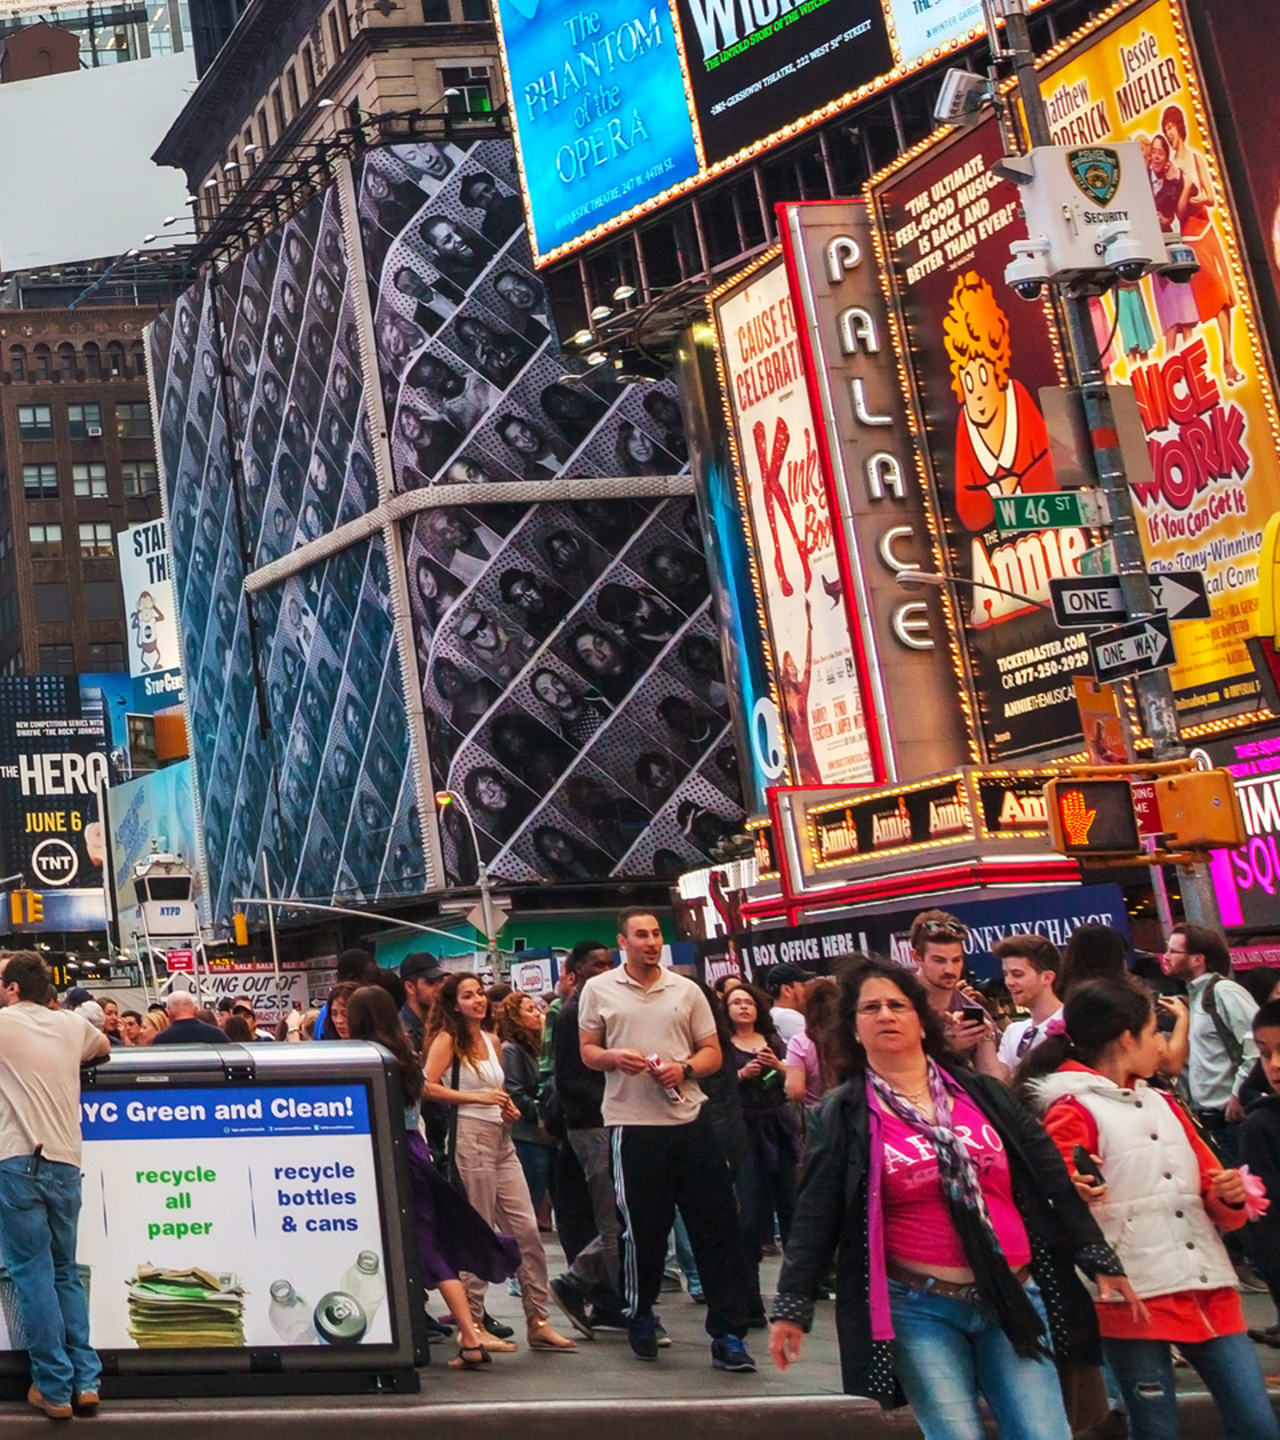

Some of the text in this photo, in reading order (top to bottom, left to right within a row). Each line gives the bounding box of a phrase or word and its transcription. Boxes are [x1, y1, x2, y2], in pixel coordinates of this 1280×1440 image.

[564, 9, 603, 48] The
[524, 7, 664, 124] PHANTOM
[1119, 31, 1159, 83] Jessie
[573, 83, 623, 130] of the
[1116, 57, 1182, 123] MUELLER
[556, 108, 650, 185] OPERA
[930, 154, 985, 202] ULTIMATE
[918, 198, 991, 257] IS BACK AND
[1083, 210, 1129, 226] SECURITY
[906, 247, 946, 286] BETTER
[944, 231, 979, 265] THAN
[826, 236, 934, 651] PALACE
[998, 497, 1071, 526] W 46 ST
[971, 527, 1089, 630] Annie
[1069, 590, 1113, 612] ONE
[997, 632, 1088, 673] TICKETMASTER.COM
[1102, 633, 1159, 667] ONE WAY
[1001, 651, 1090, 690] OR 877-250-2929
[15, 719, 104, 729] NEW COMPETITION SERIES WITH
[16, 728, 41, 737] DWAYNE
[78, 727, 105, 736] JOHNSON
[0, 751, 110, 797] THE HERO
[25, 811, 83, 833] JUNE 6
[872, 812, 912, 845] Annie
[929, 798, 971, 835] Annie
[820, 824, 857, 858] Annie
[37, 856, 72, 870] TNT
[159, 906, 181, 916] NYPD
[752, 931, 855, 967] BOX OFFICE HERE
[242, 974, 302, 992] OUT OF
[127, 1101, 205, 1122] Green
[214, 1099, 262, 1120] and
[270, 1097, 354, 1119] Clean!
[274, 1162, 355, 1183] recycle
[135, 1166, 216, 1240] recycle all paper
[277, 1188, 357, 1206] bottles
[281, 1215, 297, 1232] &
[305, 1216, 359, 1232] cans
